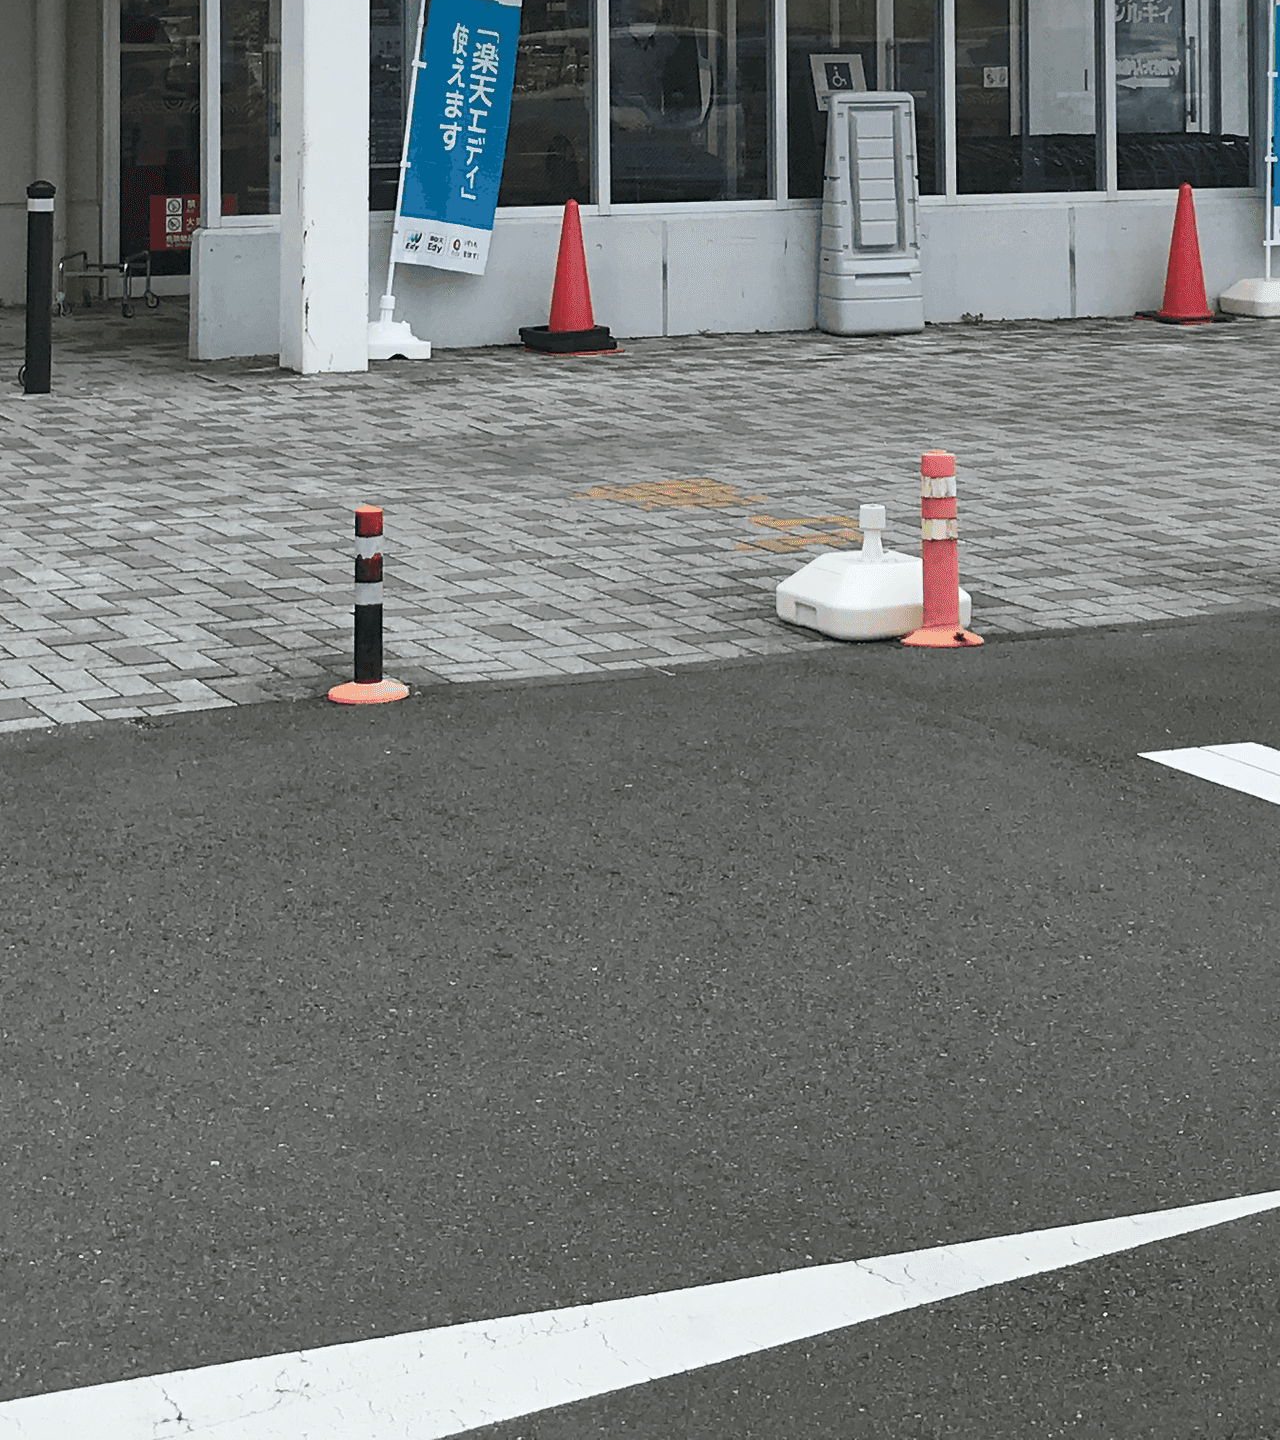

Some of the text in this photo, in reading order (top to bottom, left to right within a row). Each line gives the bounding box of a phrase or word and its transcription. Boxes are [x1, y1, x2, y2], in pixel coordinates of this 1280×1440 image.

[439, 22, 470, 151] 使えます
[461, 28, 500, 201] 「楽天エディ」
